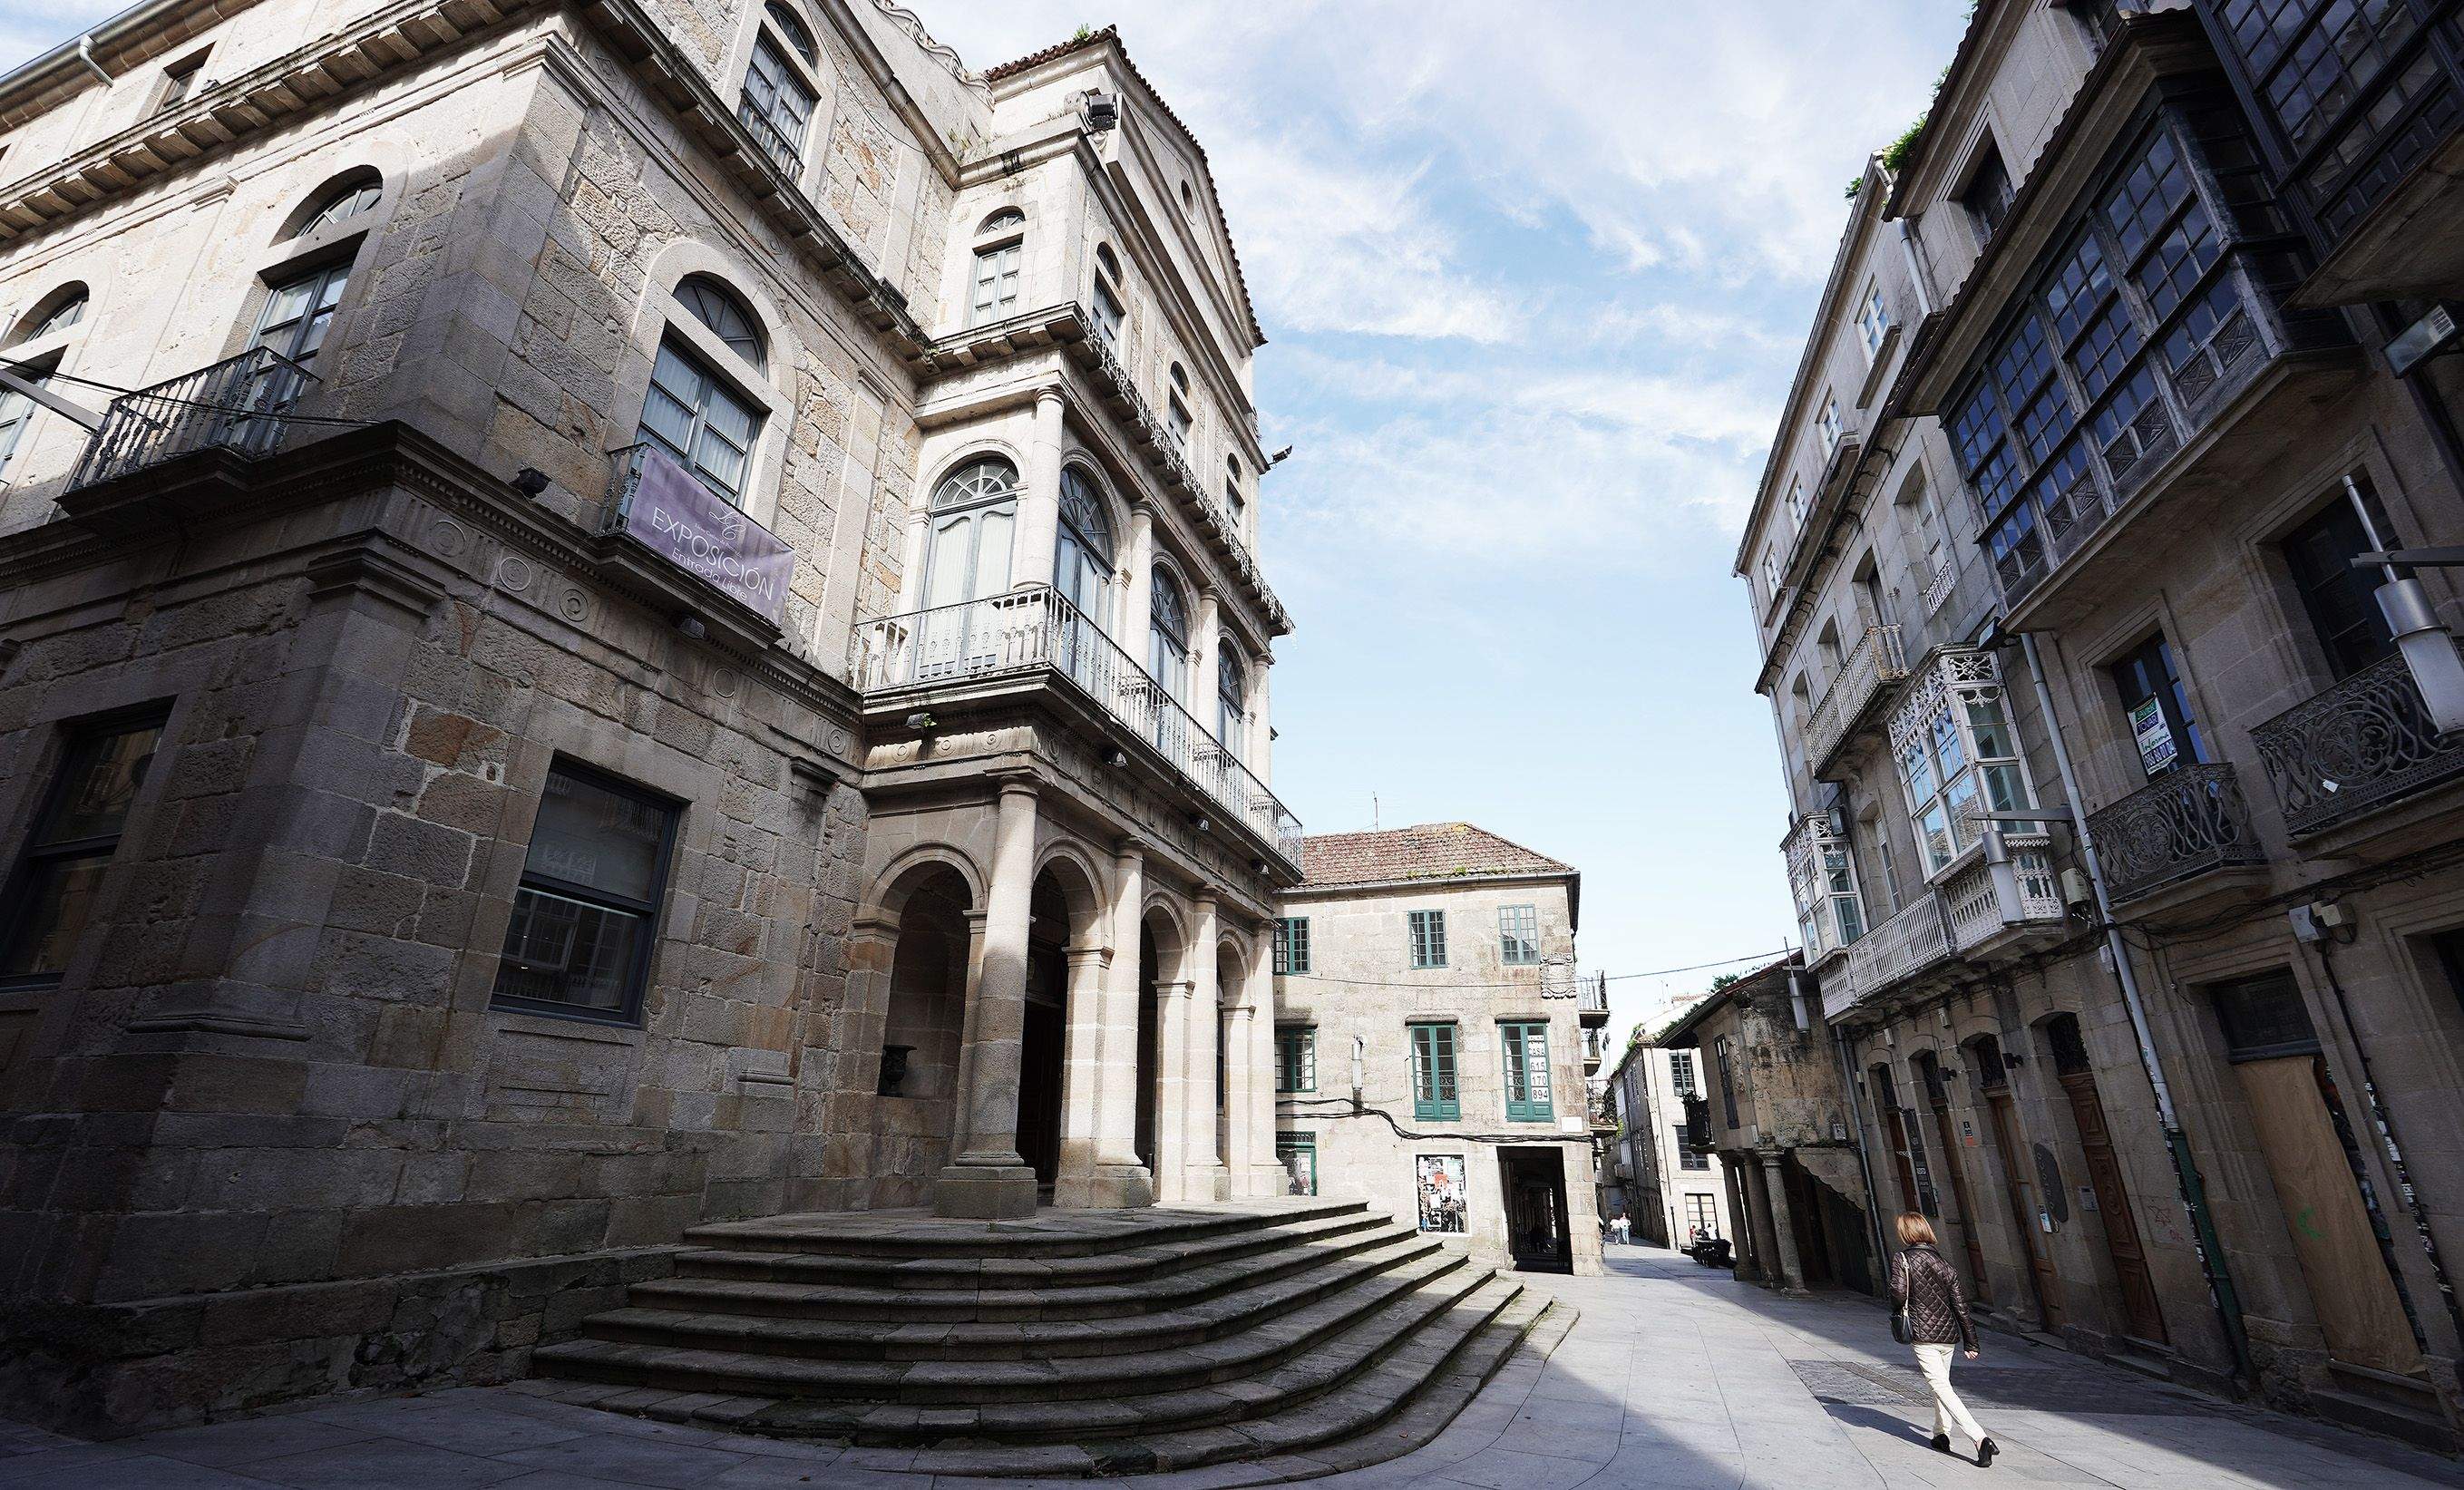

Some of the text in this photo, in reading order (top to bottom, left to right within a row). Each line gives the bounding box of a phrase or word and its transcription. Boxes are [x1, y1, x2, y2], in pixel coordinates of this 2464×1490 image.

[652, 506, 774, 600] EXPOSICIÓN
[671, 547, 721, 586] Entrada
[722, 577, 746, 600] Libre
[2138, 715, 2157, 732] TOVAR
[1530, 1061, 1546, 1071] 615
[1532, 1075, 1547, 1086] 170
[1533, 1089, 1549, 1100] 894
